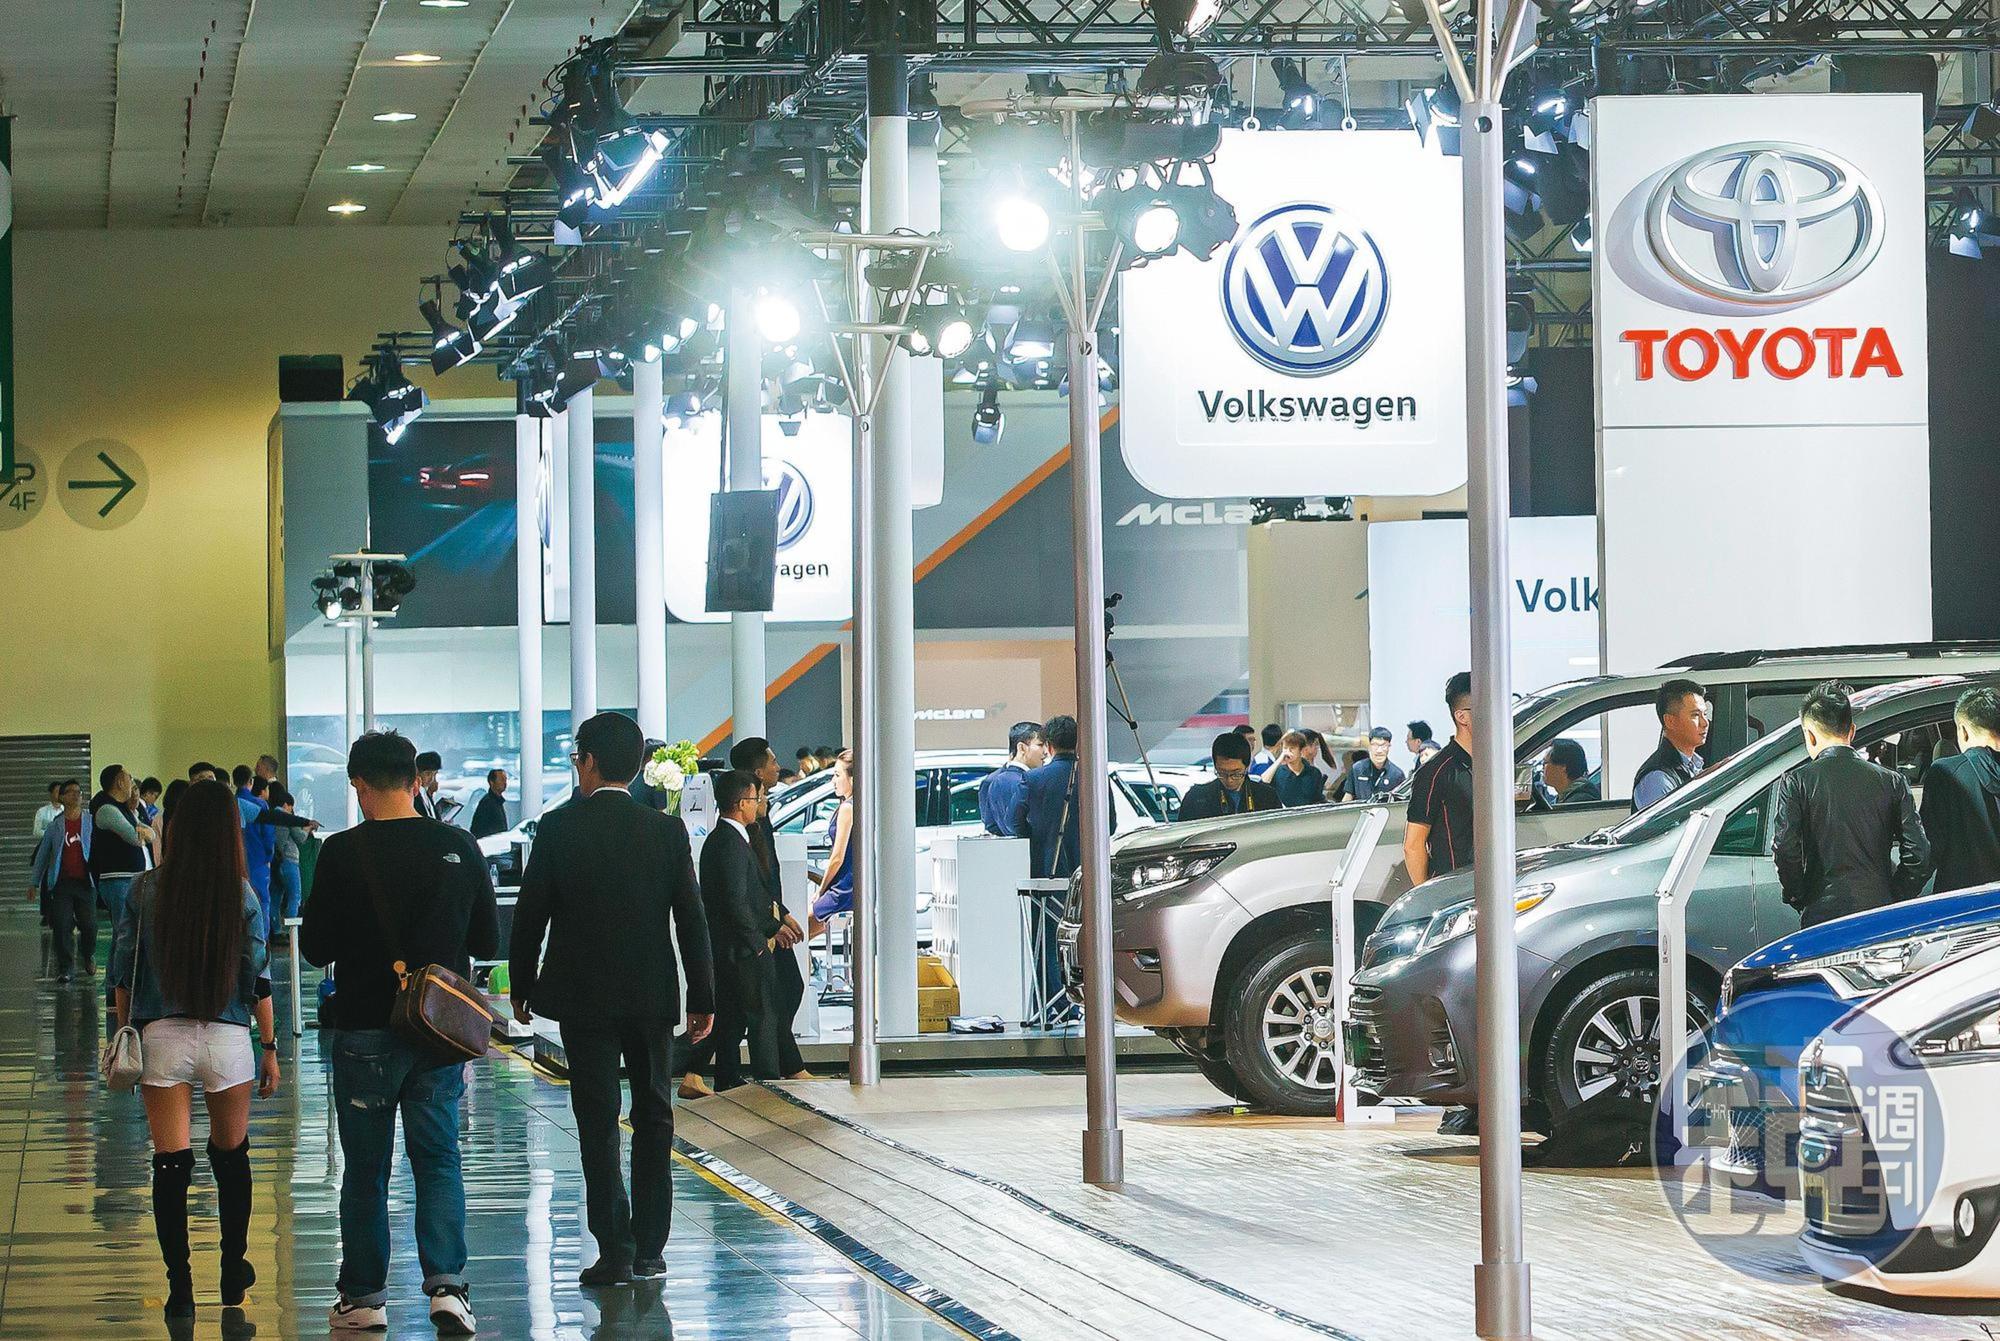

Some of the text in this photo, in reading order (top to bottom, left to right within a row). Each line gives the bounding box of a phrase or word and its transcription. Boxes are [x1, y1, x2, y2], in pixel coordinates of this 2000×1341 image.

[1619, 327, 1904, 382] TOYOTA
[1197, 389, 1417, 426] Volkswagen
[9, 491, 36, 511] 4F
[1515, 576, 1599, 613] Volk
[1705, 1102, 1727, 1121] C-HR
